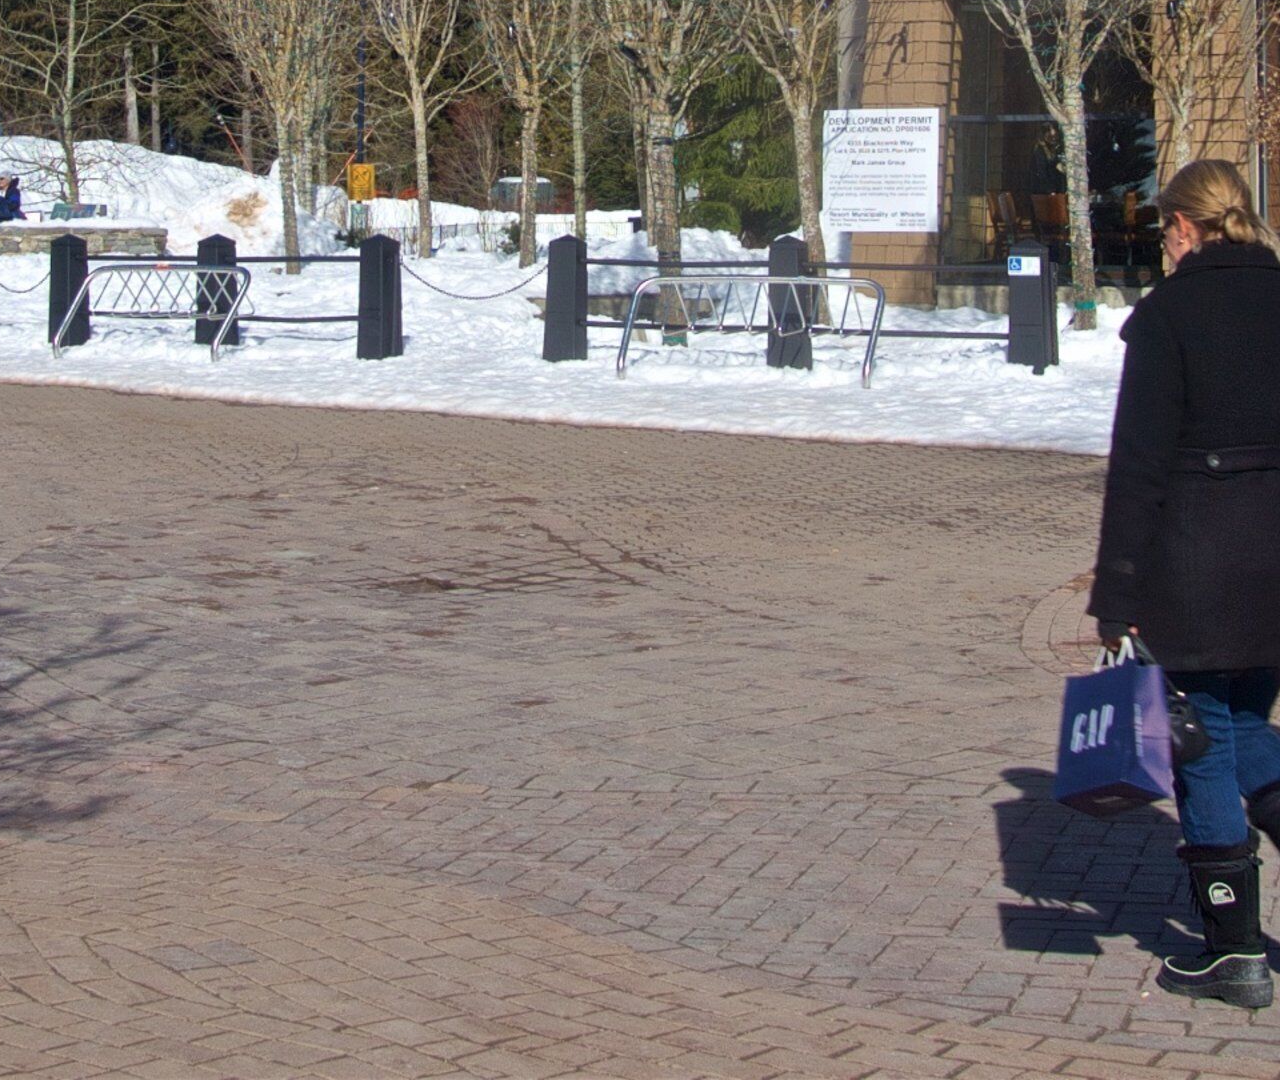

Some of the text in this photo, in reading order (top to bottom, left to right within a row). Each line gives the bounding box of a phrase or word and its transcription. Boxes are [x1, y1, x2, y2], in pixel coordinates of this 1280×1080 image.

[828, 115, 933, 126] DEVELOPMENT PERMIT
[831, 125, 879, 133] APPLICATION
[881, 125, 893, 133] NO.
[863, 139, 899, 147] Blackcomb
[900, 139, 914, 147] Way
[887, 159, 906, 167] Group
[851, 211, 888, 219] Municipality
